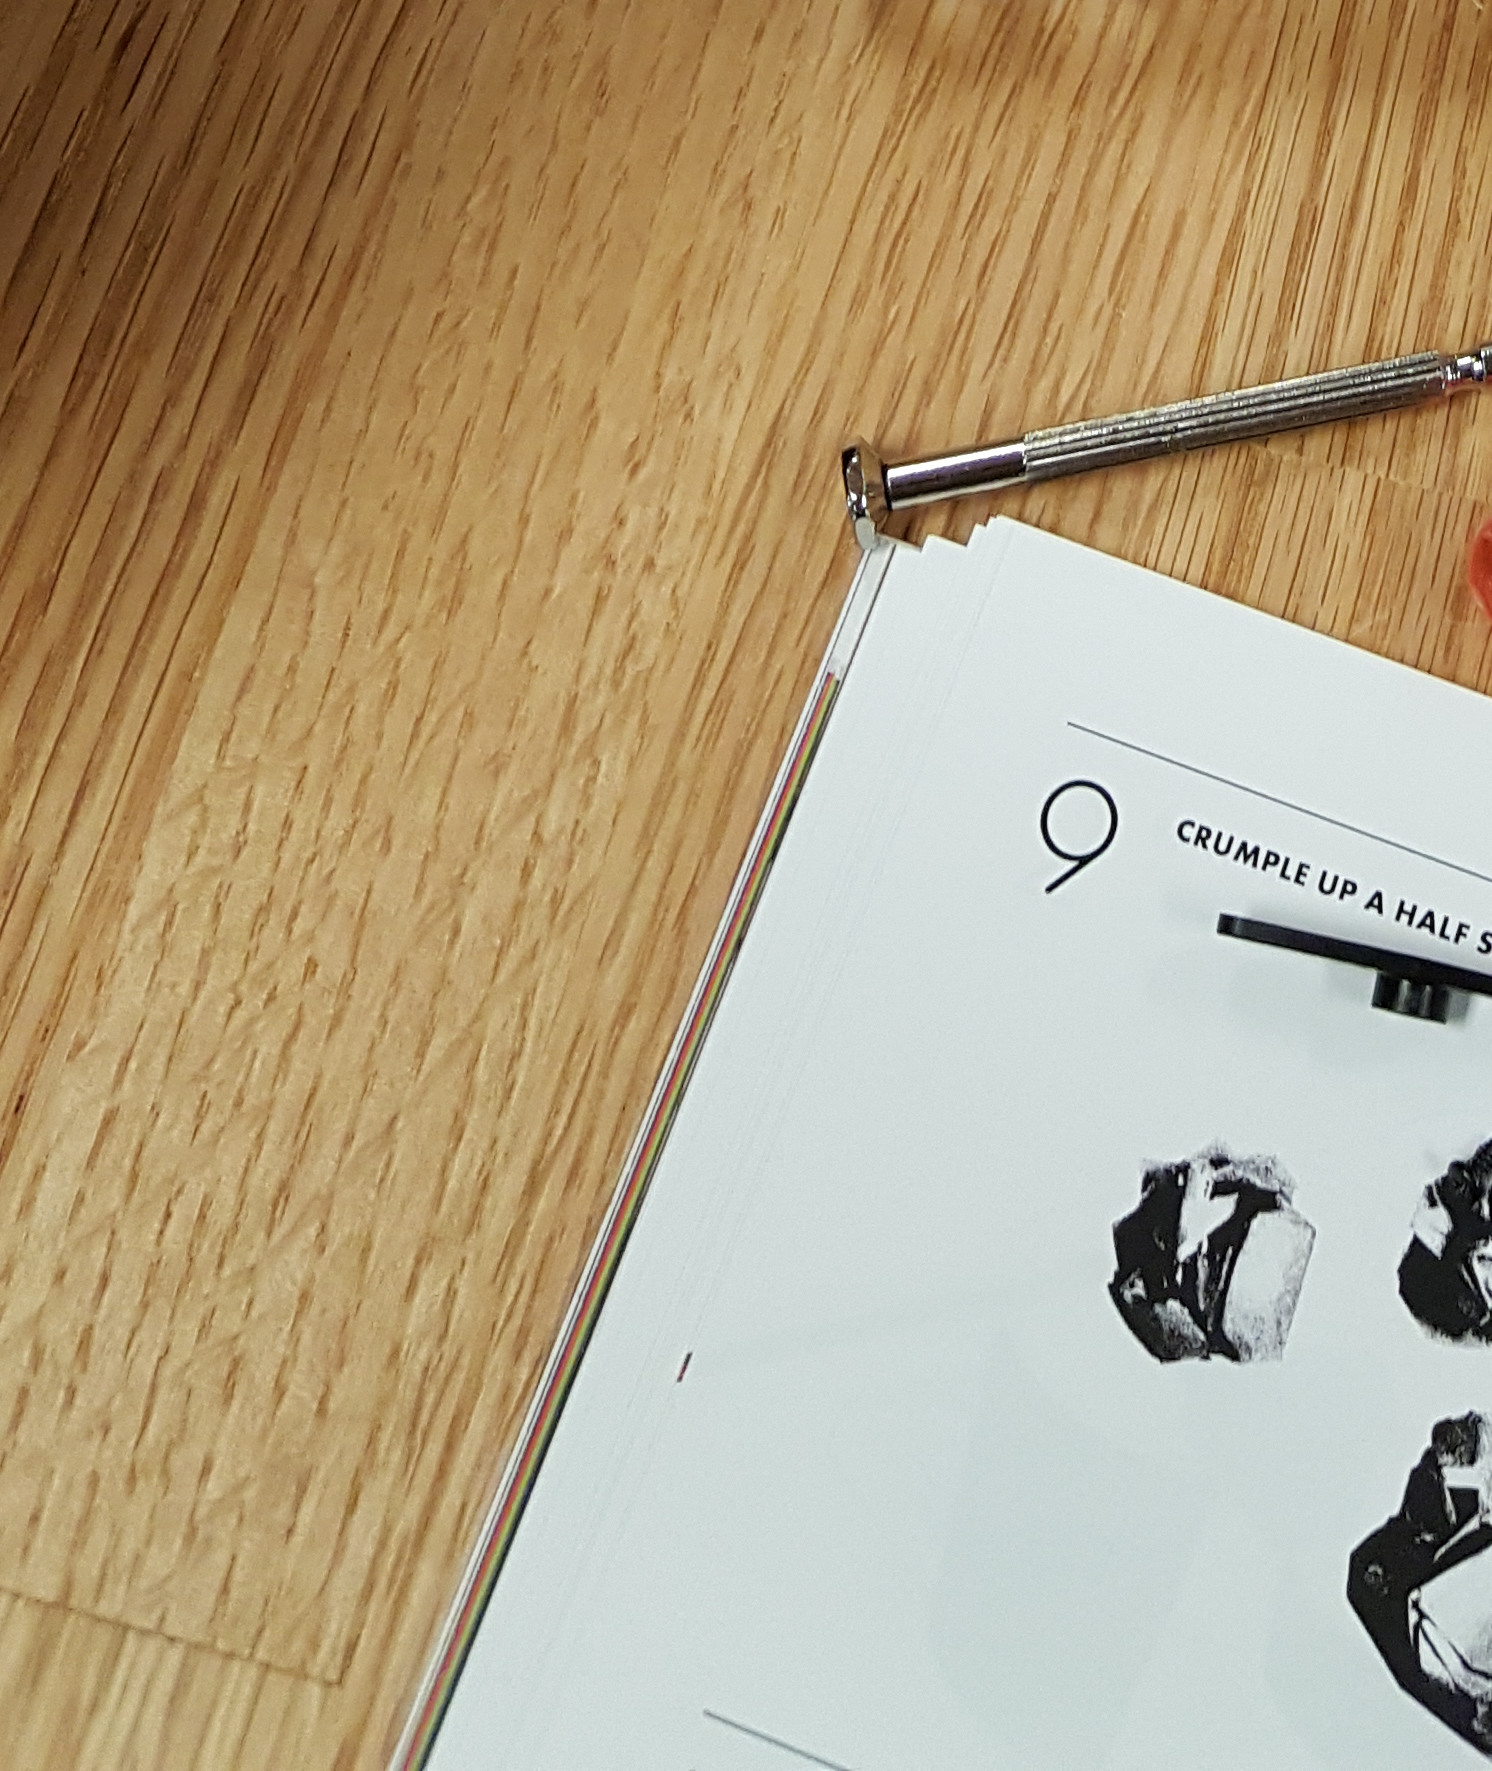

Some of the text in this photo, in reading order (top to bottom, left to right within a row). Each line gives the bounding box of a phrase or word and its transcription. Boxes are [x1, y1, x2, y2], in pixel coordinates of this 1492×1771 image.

[1040, 779, 1119, 894] 9
[1176, 819, 1311, 887] CRUMPLE
[1318, 870, 1358, 900] UP
[1364, 890, 1384, 915] A
[1395, 900, 1471, 945] HALF
